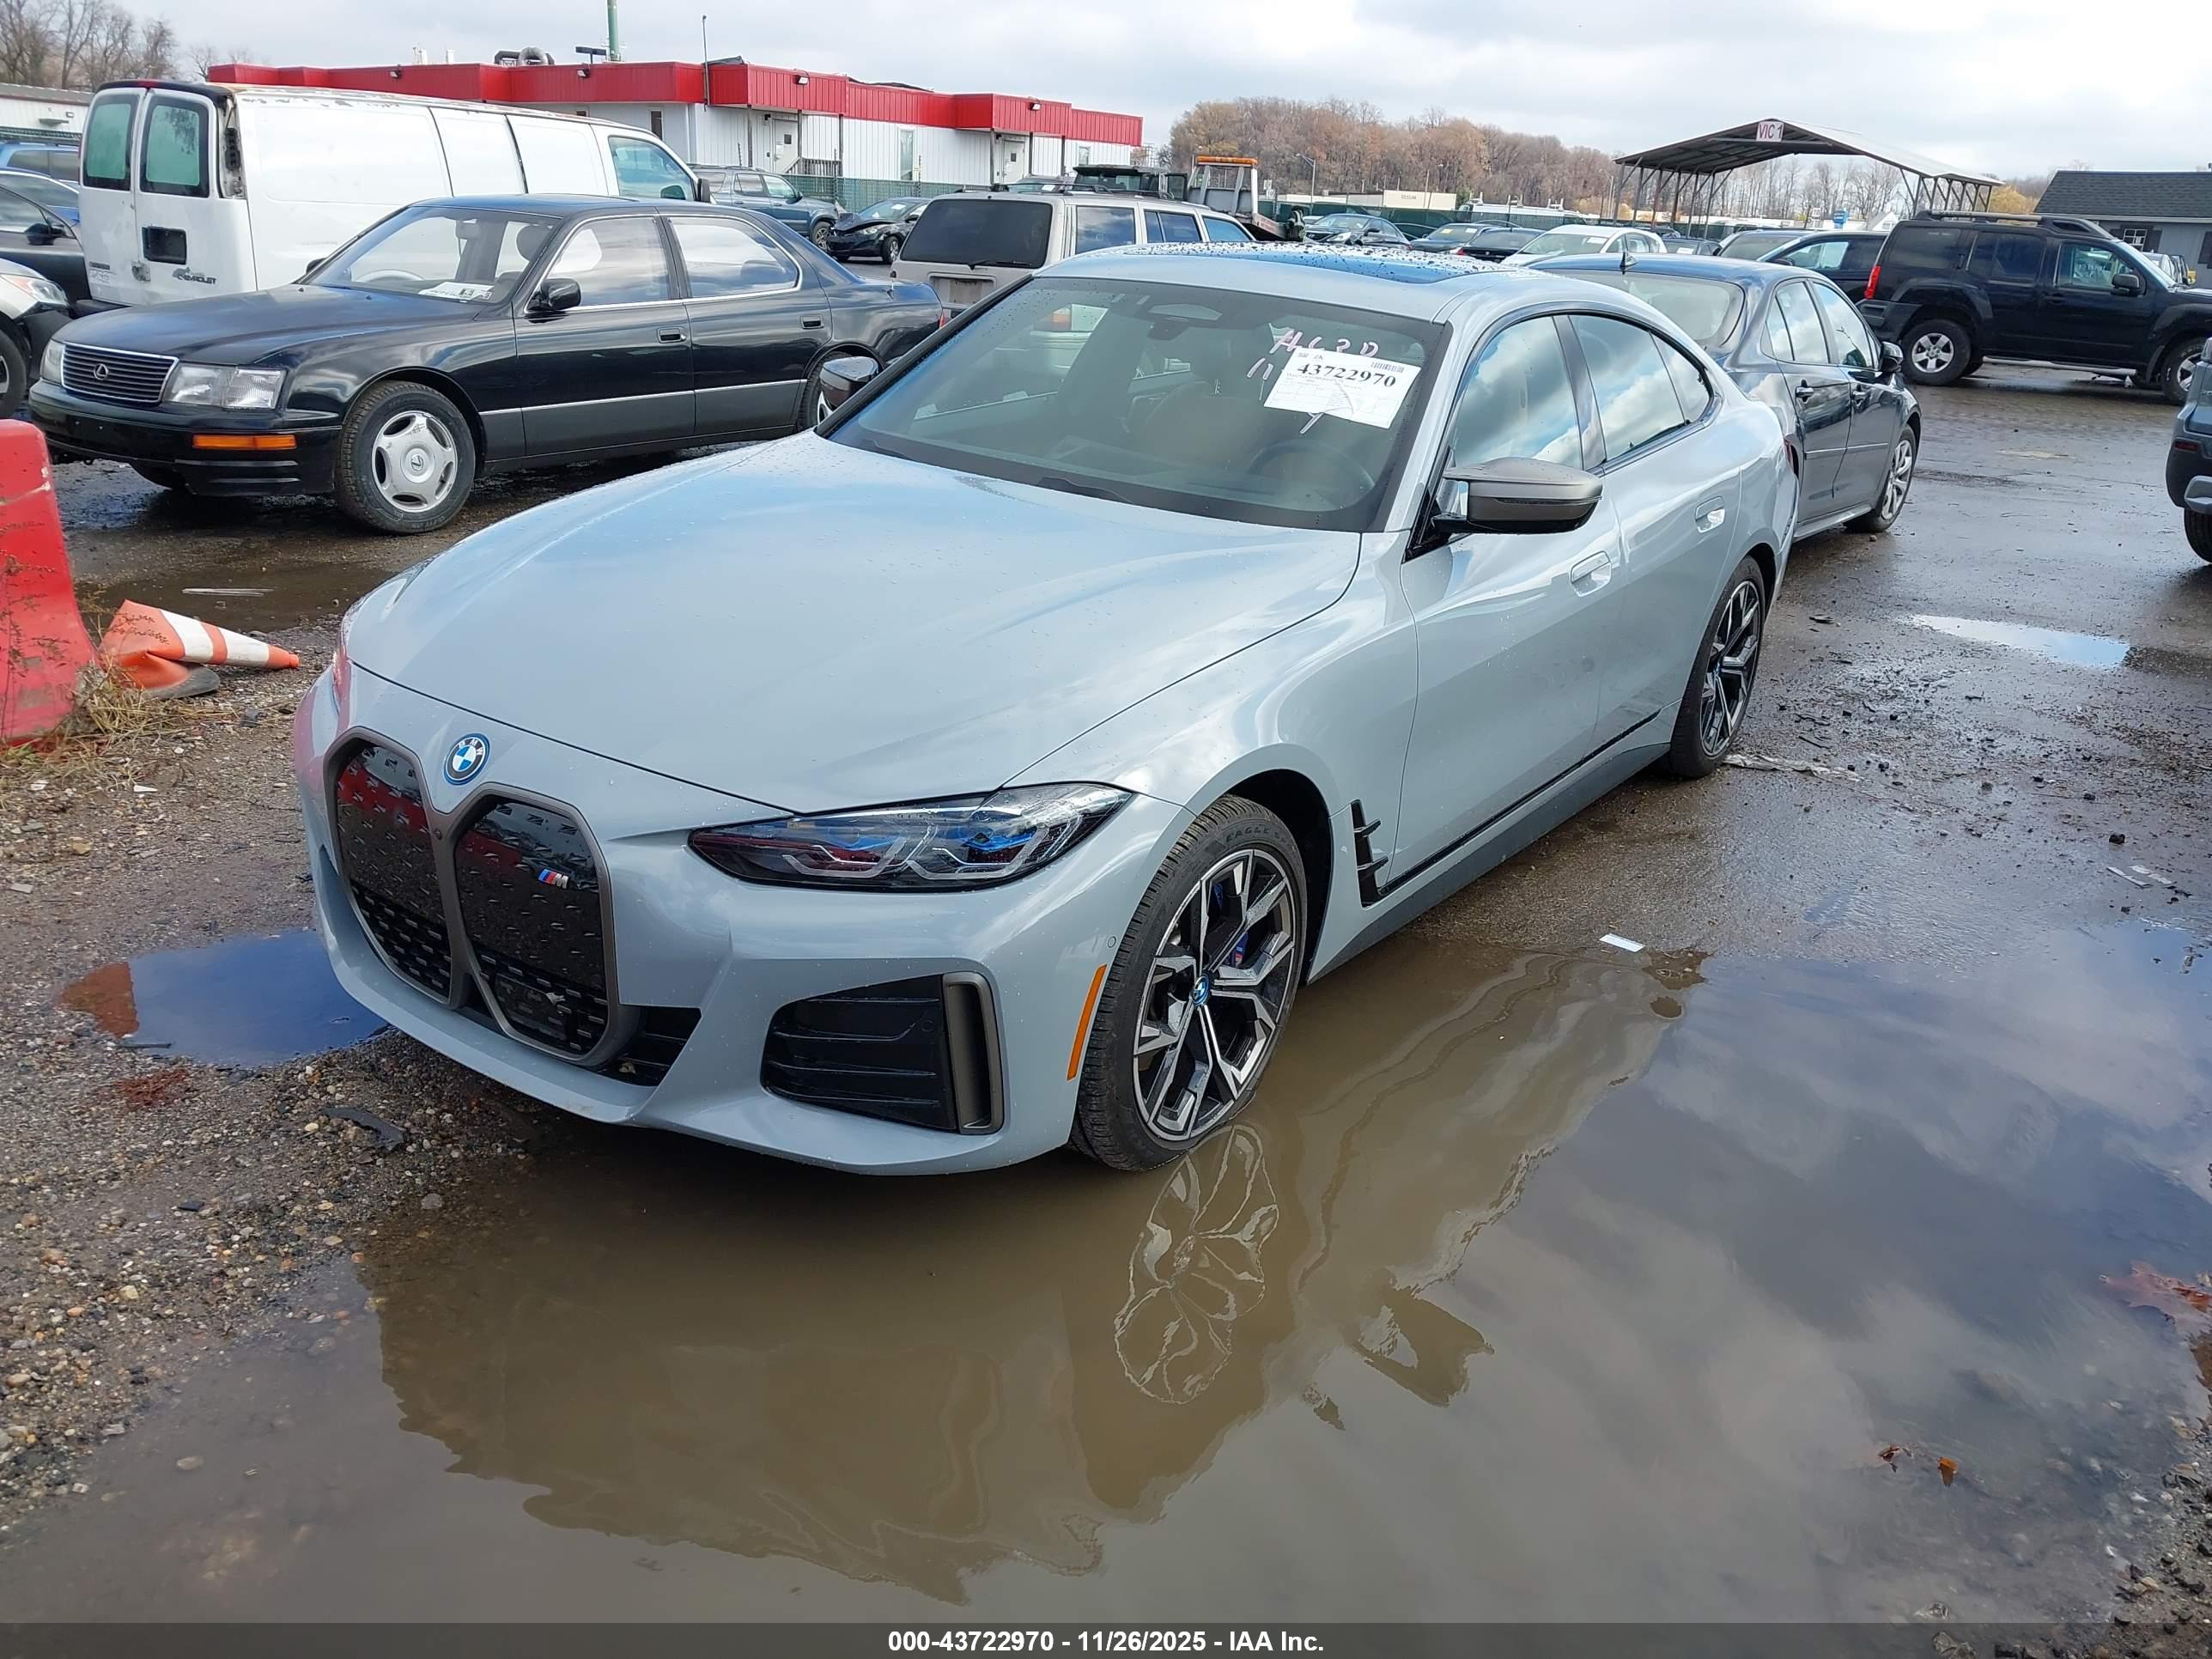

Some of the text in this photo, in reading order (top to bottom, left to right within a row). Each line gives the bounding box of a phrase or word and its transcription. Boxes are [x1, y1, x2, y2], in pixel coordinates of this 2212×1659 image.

[1759, 124, 1783, 138] VIC 1
[1297, 363, 1396, 387] 43722970
[459, 738, 484, 756] BMW
[1226, 826, 1270, 842] EAGLE
